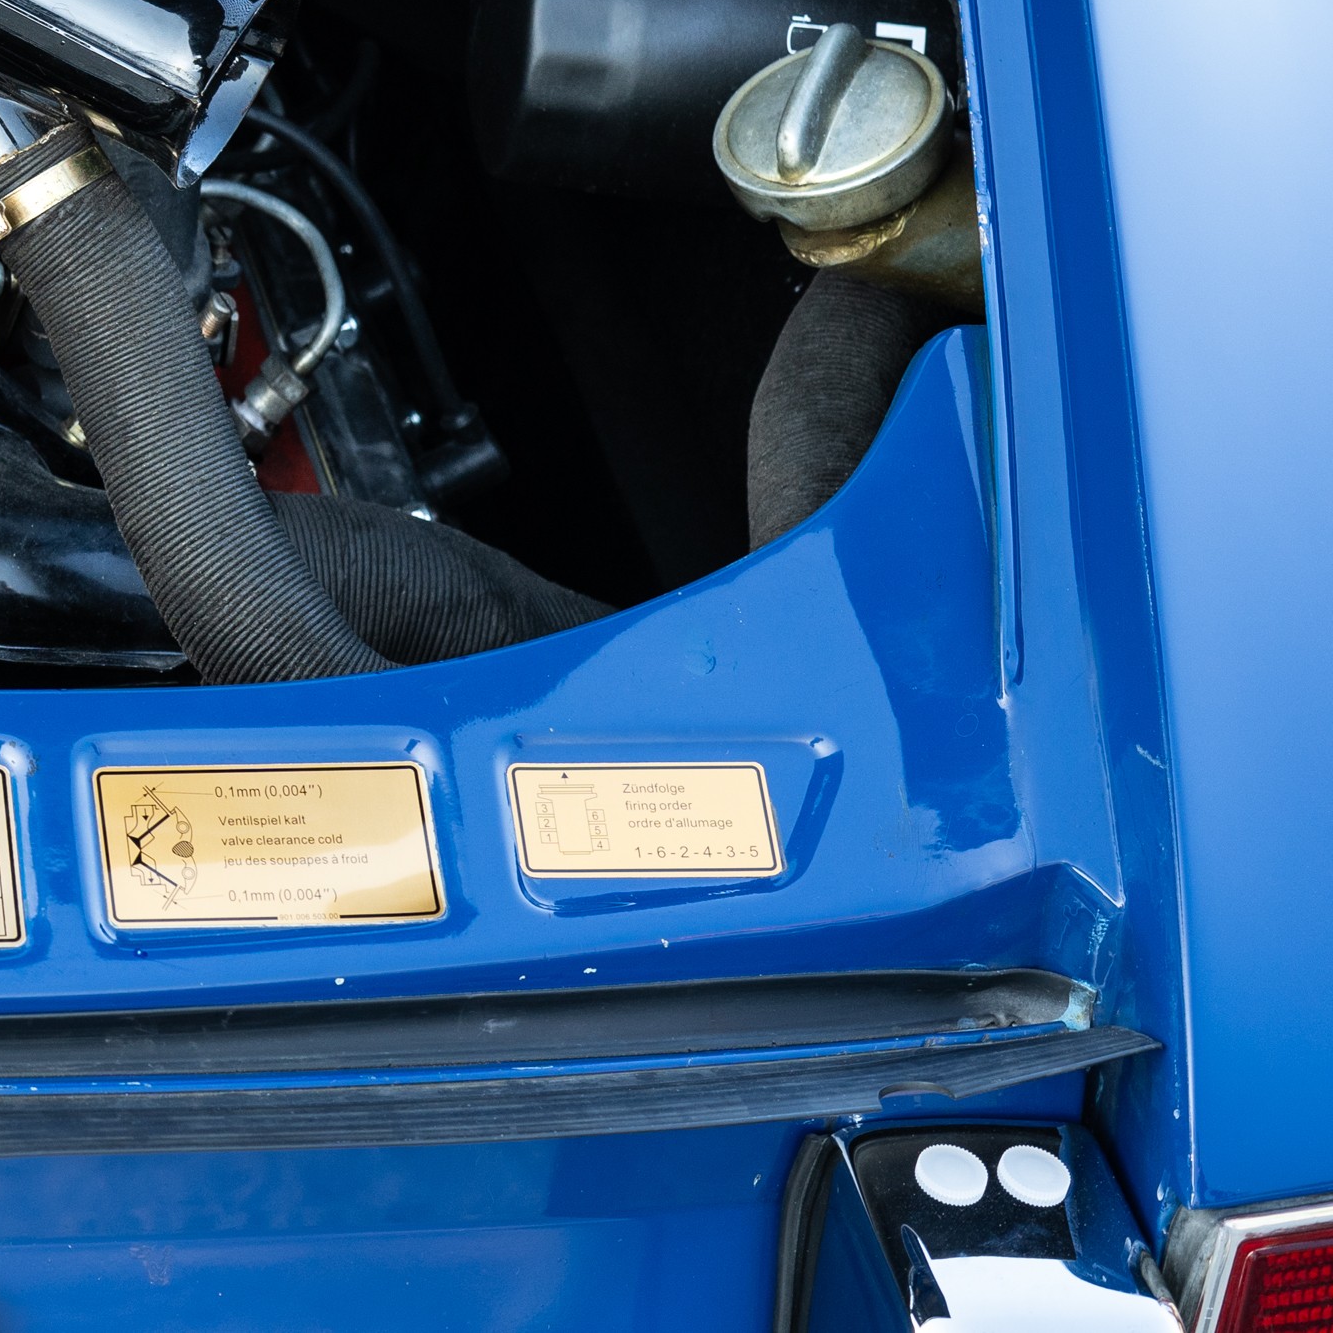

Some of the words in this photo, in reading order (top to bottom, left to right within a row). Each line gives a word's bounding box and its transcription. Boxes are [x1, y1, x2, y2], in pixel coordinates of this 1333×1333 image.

[621, 782, 685, 796] Zündfolge
[625, 800, 657, 814] firing
[658, 800, 693, 811] order
[217, 815, 282, 828] Ventilspiel
[283, 814, 306, 825] kalt
[628, 817, 661, 829] ordre
[664, 817, 733, 831] d'allumage
[220, 835, 253, 846] valve
[255, 835, 315, 846] clearance
[317, 833, 343, 845] cold
[223, 855, 242, 869] jeu
[245, 855, 267, 866] des
[269, 856, 329, 867] soupapes
[341, 853, 369, 864] froid
